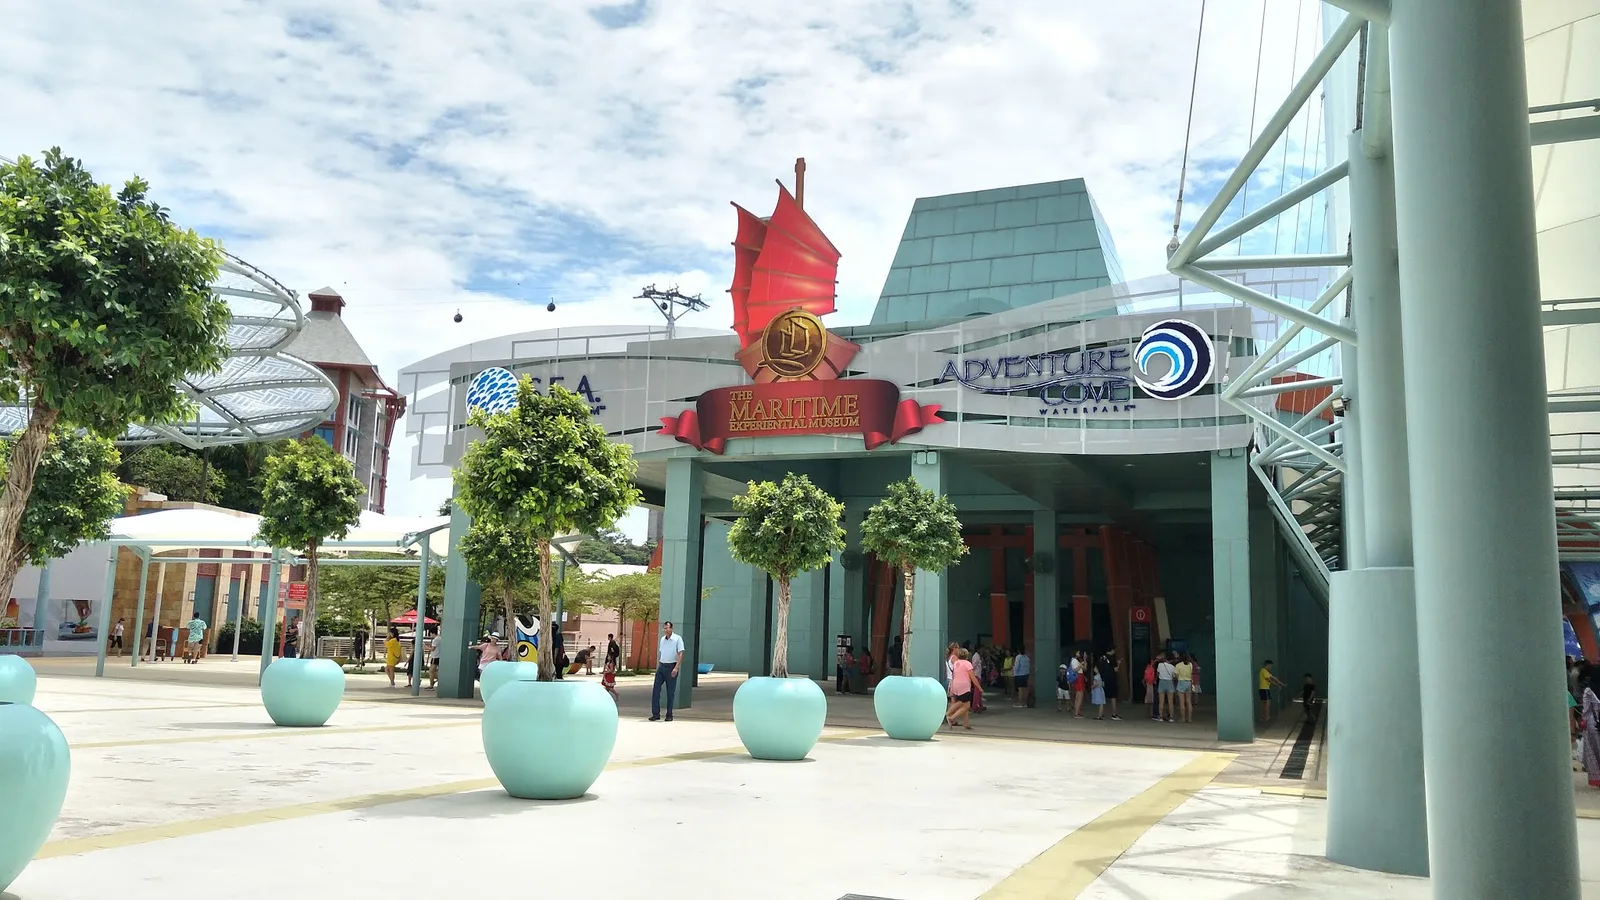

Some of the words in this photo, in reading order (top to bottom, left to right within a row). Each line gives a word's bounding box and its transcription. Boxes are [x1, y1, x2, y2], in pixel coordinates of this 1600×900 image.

[938, 348, 1131, 382] ADVENTURE
[729, 390, 753, 401] THE
[1039, 380, 1131, 406] COVE
[729, 394, 859, 422] MARITIME
[729, 418, 808, 431] EXPERIENTIAL
[809, 416, 860, 429] MUSEUM
